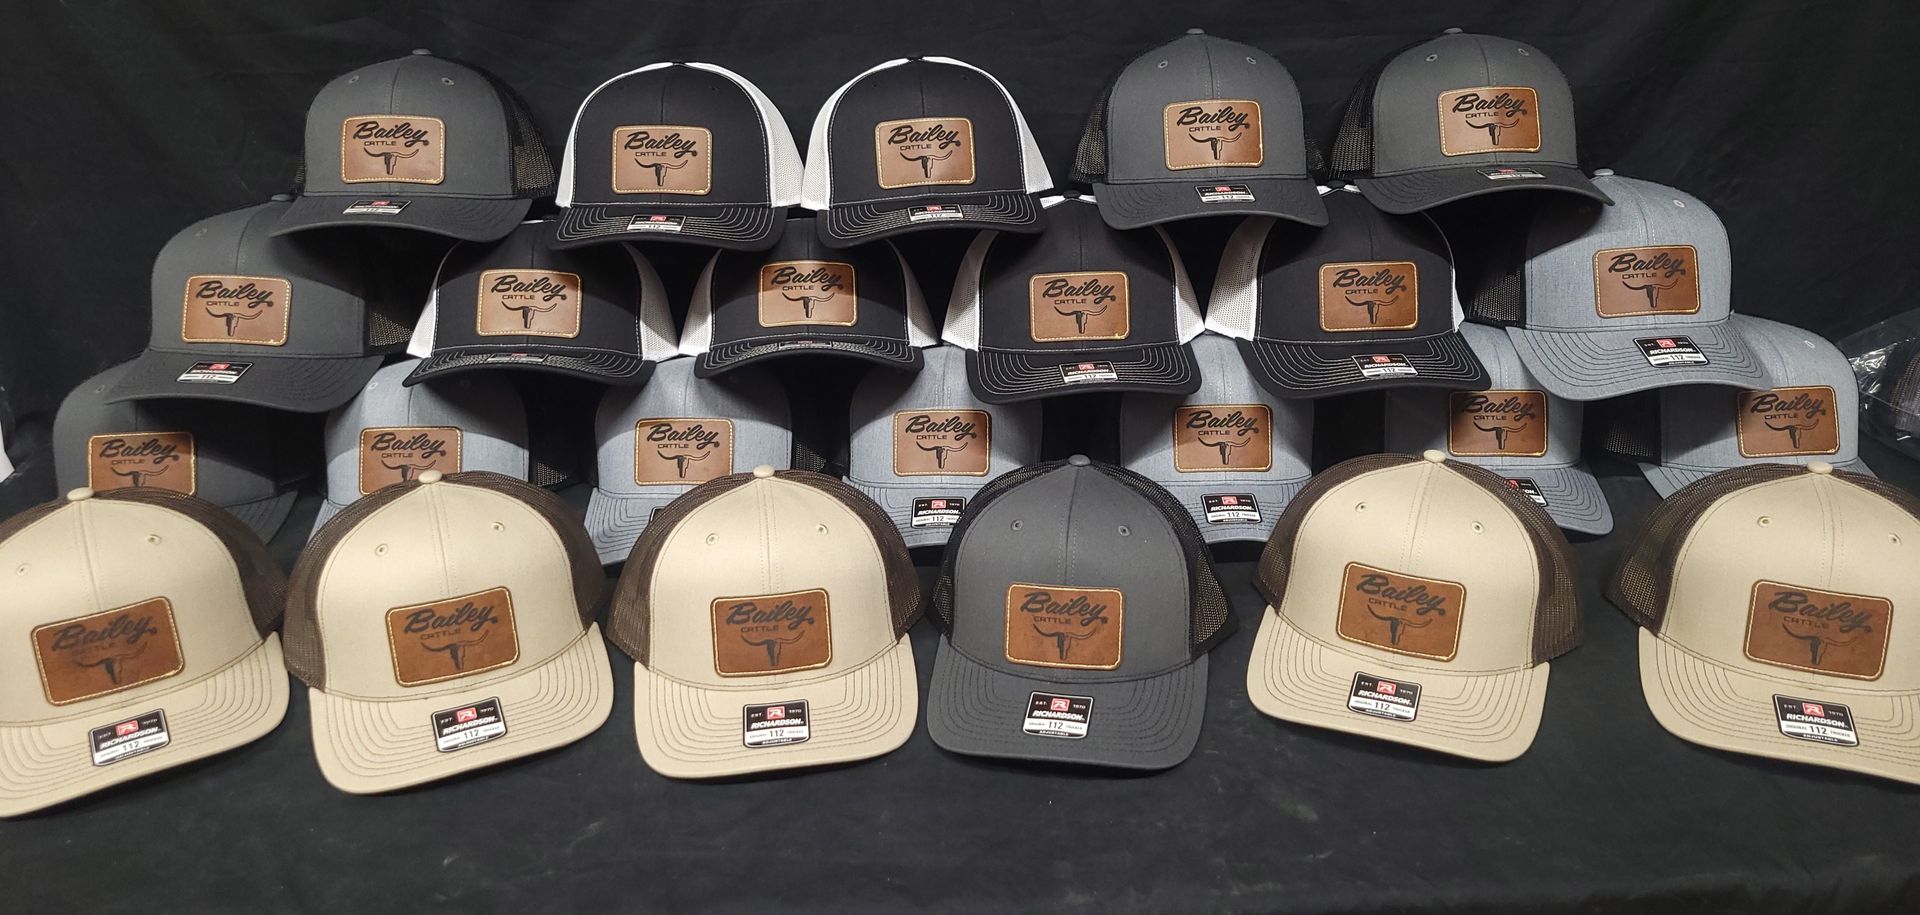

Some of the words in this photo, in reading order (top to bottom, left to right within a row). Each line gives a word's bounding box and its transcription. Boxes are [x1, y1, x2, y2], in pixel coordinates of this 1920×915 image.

[1453, 92, 1527, 118] Bailey
[1465, 111, 1499, 119] CATTLE
[1177, 106, 1250, 131] Bailey
[353, 121, 429, 147] Bailey
[624, 132, 698, 158] Bailey
[888, 124, 961, 150] Bailey
[1608, 253, 1686, 278] Bailey
[491, 275, 566, 301] Bailey
[771, 267, 843, 291] Bailey
[1042, 278, 1116, 303] Bailey
[1333, 269, 1407, 295] Bailey
[196, 281, 274, 308] Bailey
[1462, 395, 1536, 422] Bailey
[1751, 392, 1826, 419] Bailey
[905, 415, 977, 441] Bailey
[1186, 409, 1259, 436] Bailey
[371, 432, 446, 459] Bailey
[646, 423, 719, 450] Bailey
[99, 439, 179, 464] Bailey
[1357, 574, 1446, 615] Bailey
[1368, 598, 1407, 612] CATTLE
[404, 602, 498, 634] Bailey
[725, 601, 815, 630] Bailey
[1020, 592, 1108, 626] Bailey
[1033, 616, 1071, 624] CATTLE
[1768, 592, 1872, 633] Bailey
[51, 613, 157, 651] Bailey
[420, 629, 462, 640] CATTLE
[740, 625, 779, 633] CATTLE
[1783, 616, 1828, 629] CATTLE
[1358, 690, 1411, 705] RICHARDSON
[1374, 701, 1390, 710] 112
[443, 716, 495, 735] RICHARDSON
[751, 719, 802, 729] RICHARDSON
[1032, 711, 1083, 720] RICHARDSON
[1787, 713, 1845, 727] RICHARDSON
[100, 727, 158, 749] RICHARDSON
[464, 729, 479, 739] 112
[769, 729, 784, 737] 112
[1810, 726, 1826, 734] 112
[123, 741, 140, 751] 112
